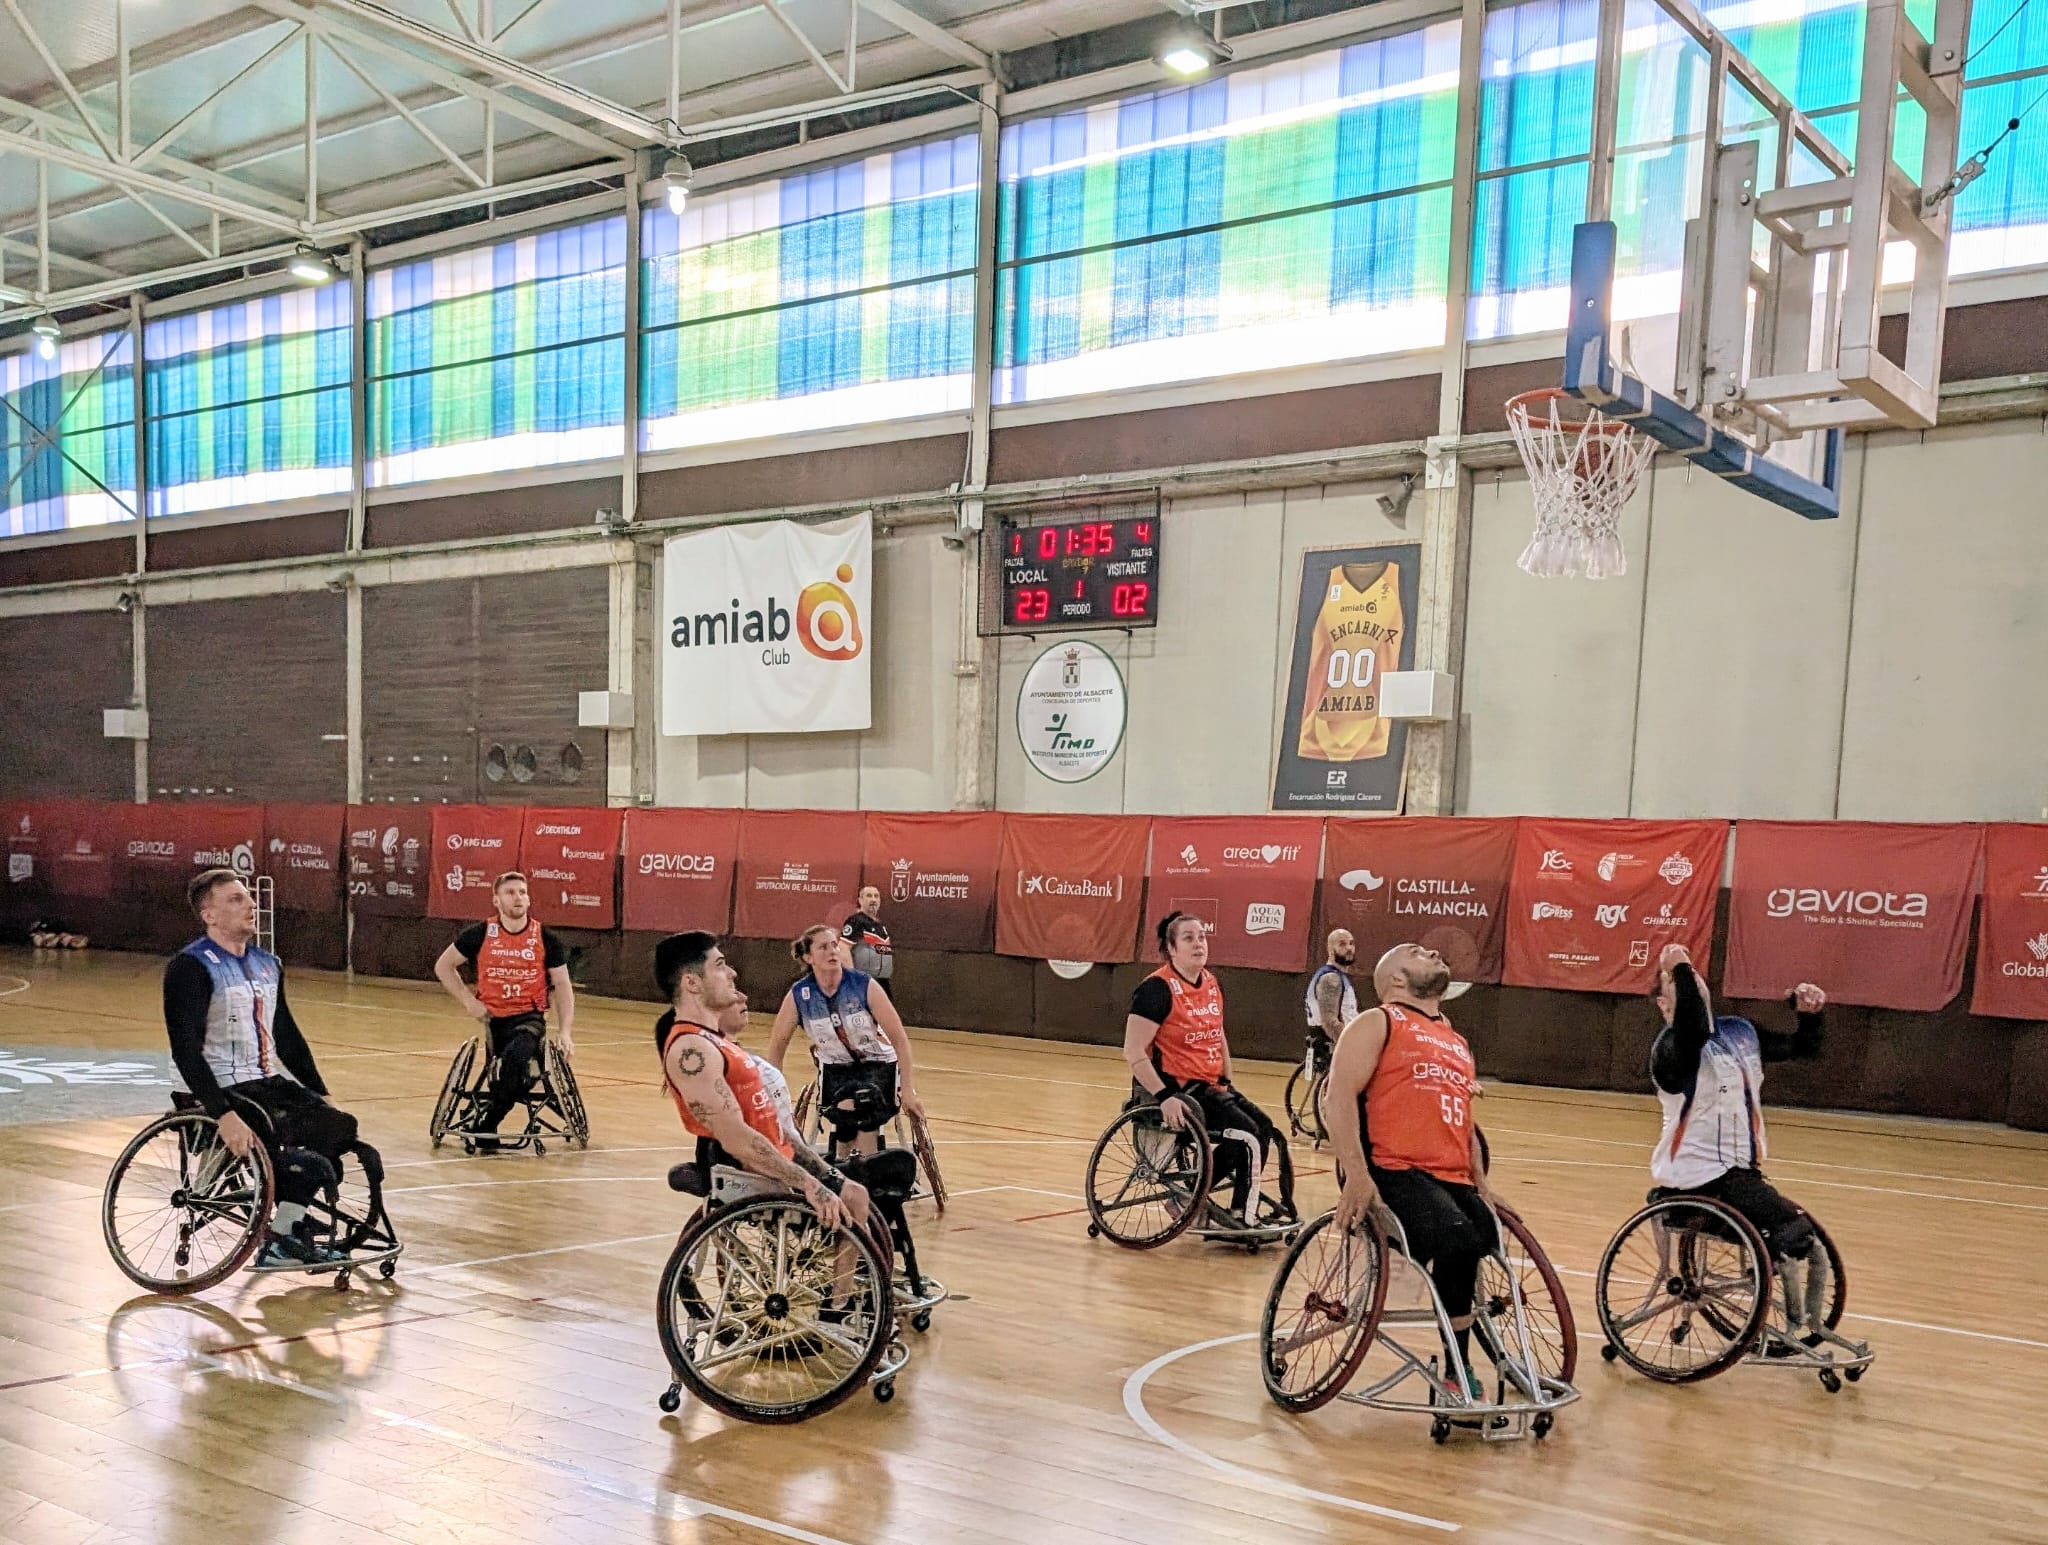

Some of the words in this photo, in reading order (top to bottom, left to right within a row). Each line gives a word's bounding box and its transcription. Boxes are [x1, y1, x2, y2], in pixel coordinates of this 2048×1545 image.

[1039, 522, 1115, 559] 01:35
[1135, 522, 1150, 544] 4
[1013, 533, 1021, 554] 1
[1131, 548, 1152, 557] FALTAS
[1005, 557, 1024, 567] FALTAS
[1107, 561, 1147, 576] VISITANTE
[1010, 569, 1048, 584] LOCAL
[1075, 580, 1083, 600] 1
[1015, 590, 1050, 621] 23
[1113, 583, 1149, 615] 02
[1063, 603, 1091, 615] PERIODO
[1340, 604, 1365, 613] amiab
[671, 597, 790, 648] amiab
[762, 648, 790, 666] Club
[1327, 648, 1376, 689] 00
[1083, 688, 1113, 697] ALBACETE
[1319, 695, 1375, 713] AMIAB
[1327, 770, 1348, 785] ER
[1289, 793, 1325, 801] Encarnación
[545, 825, 581, 835] DECATHLON
[128, 841, 175, 857] gaviota
[481, 839, 503, 848] LONG
[193, 847, 230, 865] amiab
[1223, 847, 1260, 860] area
[1282, 845, 1299, 861] fit
[639, 854, 715, 874] gaviota
[915, 872, 969, 885] Ayuntamiento
[791, 883, 801, 891] DE
[802, 884, 838, 893] ALBACETE
[914, 884, 969, 899] ALBACETE
[1045, 876, 1113, 898] CaixaBank
[1397, 879, 1476, 896] CASTILLA-
[1395, 900, 1416, 915] LA
[1418, 901, 1489, 918] MANCHA
[1767, 888, 1928, 918] gaviota
[1251, 907, 1282, 916] AQUA
[1594, 904, 1630, 929] RGK
[1251, 916, 1280, 925] DEUS
[1804, 915, 1819, 924] The
[1820, 916, 1836, 924] Sun
[1837, 917, 1845, 925] &
[1846, 917, 1878, 927] Shutter
[1879, 918, 1924, 929] Specialists
[491, 949, 521, 957] amiab
[830, 1013, 842, 1028] 8
[1440, 1094, 1464, 1127] 55
